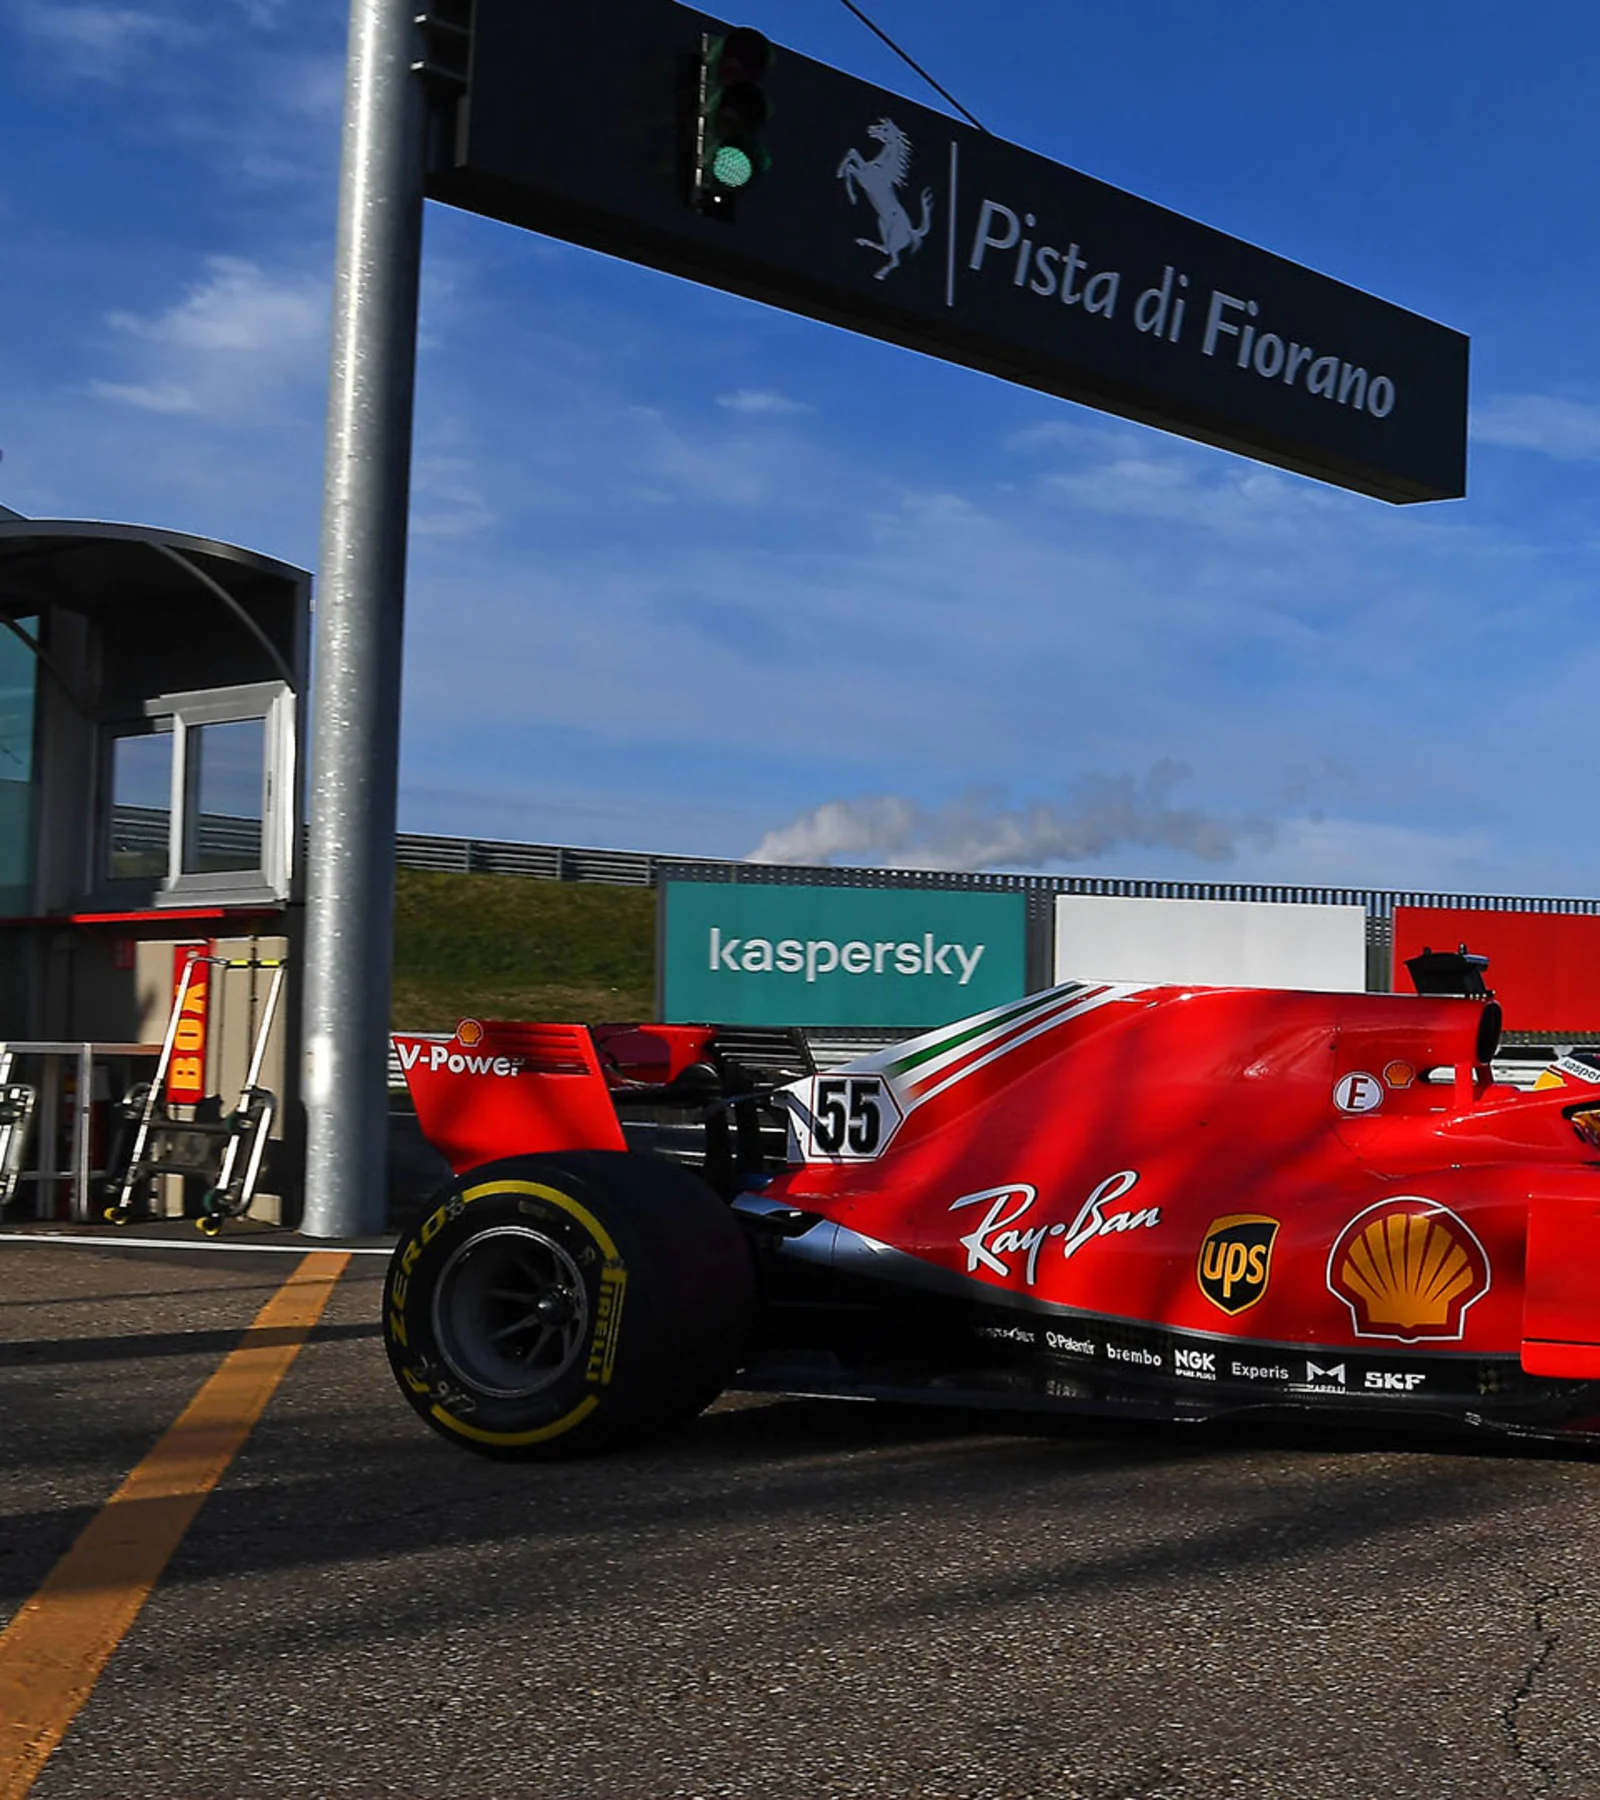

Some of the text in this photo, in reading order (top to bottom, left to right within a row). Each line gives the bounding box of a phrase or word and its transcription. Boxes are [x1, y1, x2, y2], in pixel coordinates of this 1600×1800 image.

[969, 199, 1396, 418] Pista di Fiorano
[709, 927, 985, 985] kaspersky
[170, 982, 207, 1090] BOX
[396, 1043, 523, 1078] V-Power
[814, 1081, 881, 1155] 55
[1346, 1077, 1369, 1109] E
[389, 1204, 446, 1347] ZERO
[1202, 1238, 1267, 1299] ups
[586, 1267, 627, 1386] PIRELLI
[1106, 1343, 1162, 1367] brembo
[1174, 1349, 1216, 1371] NGK
[1231, 1361, 1290, 1380] Experis
[1364, 1371, 1426, 1391] SKF
